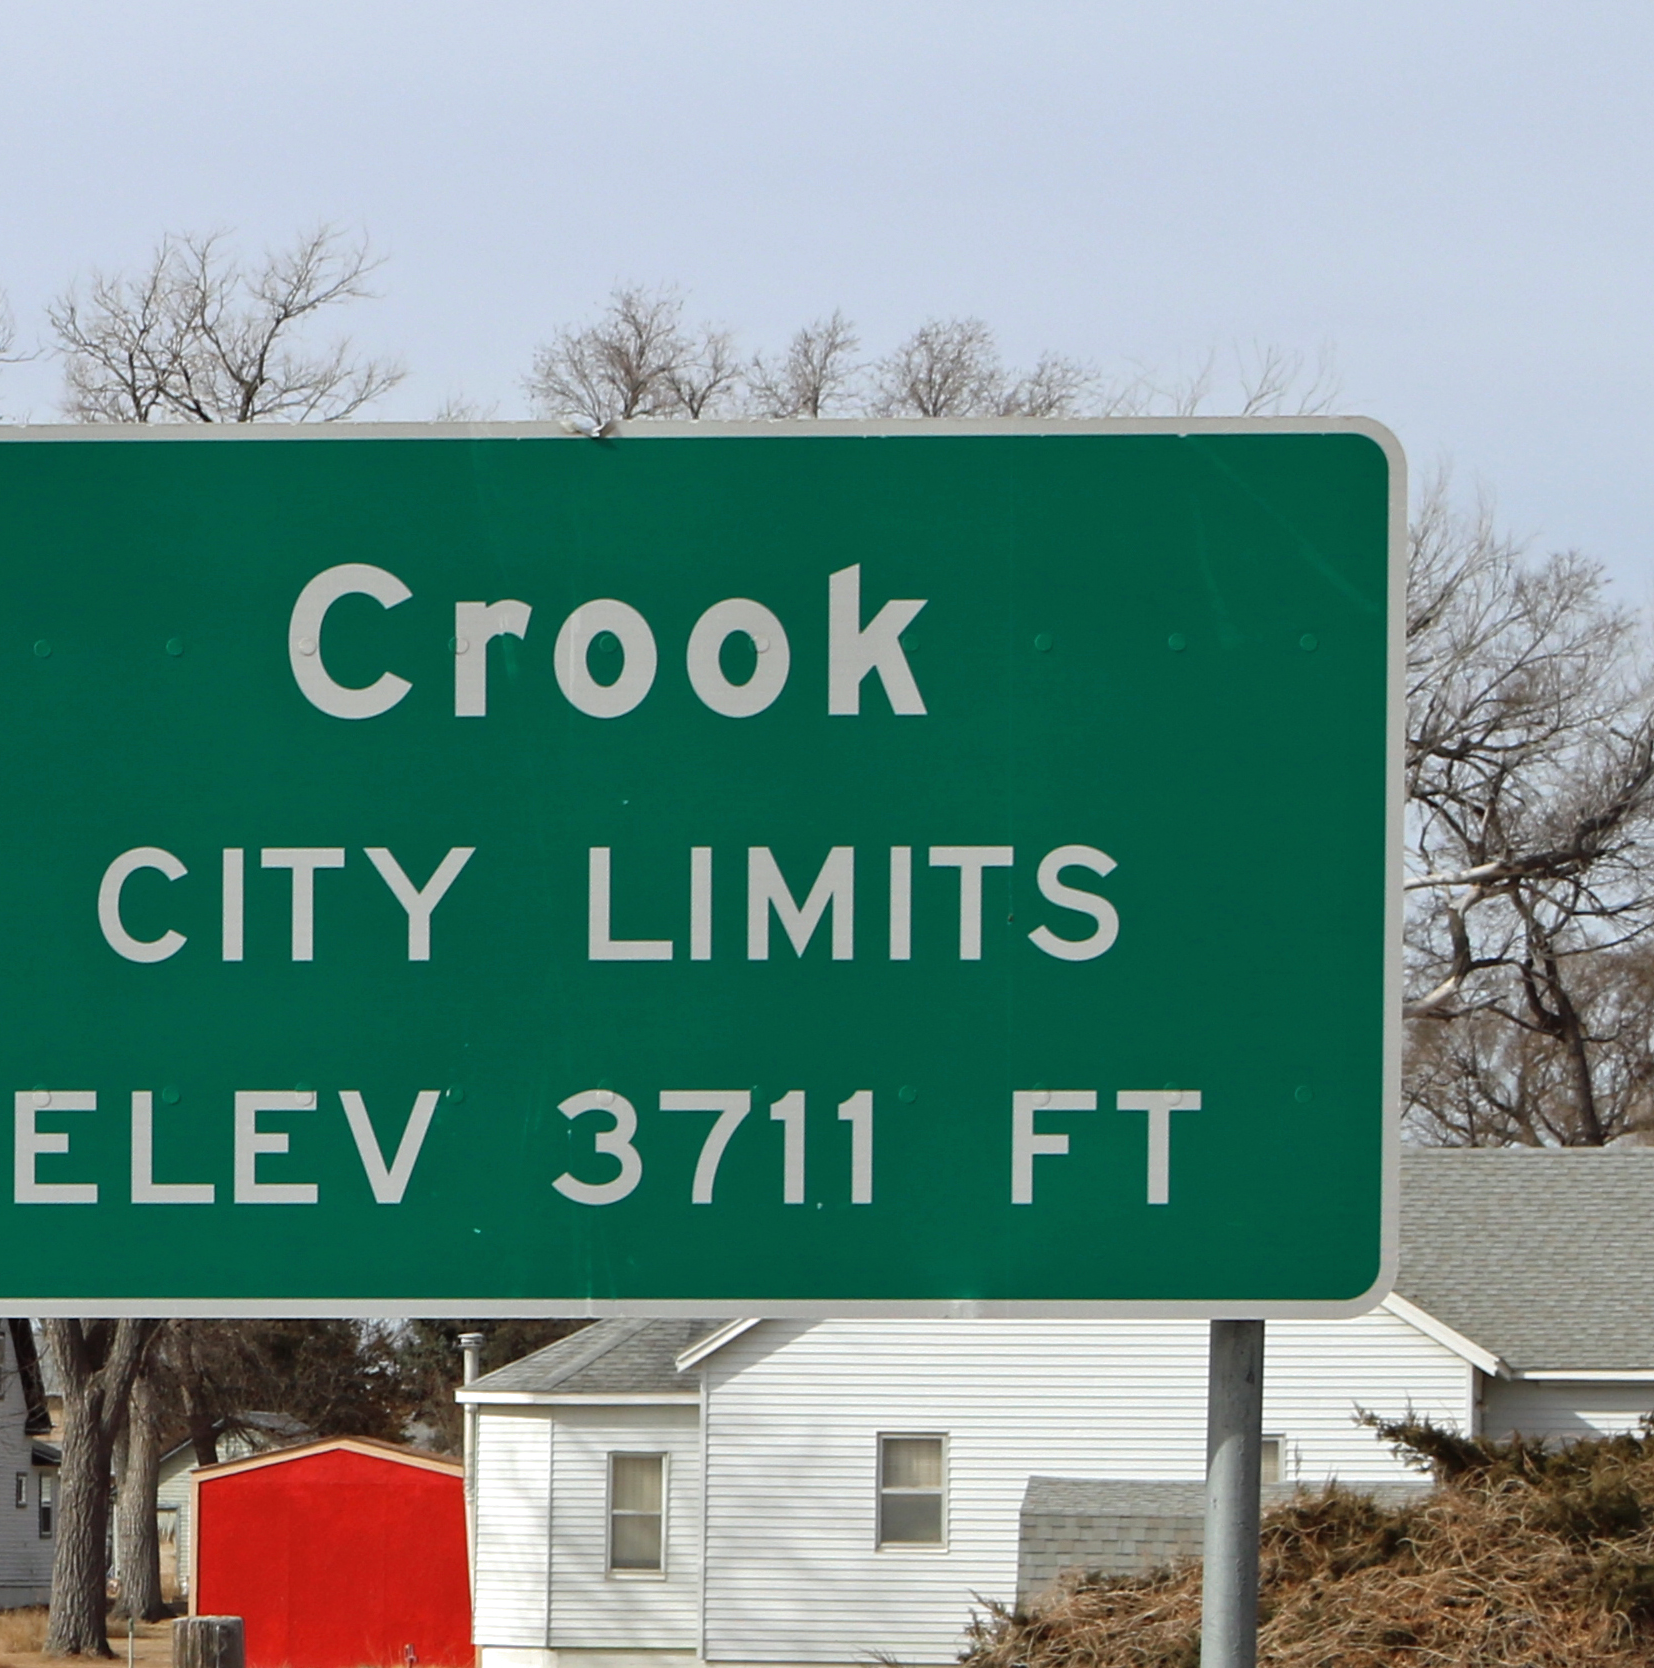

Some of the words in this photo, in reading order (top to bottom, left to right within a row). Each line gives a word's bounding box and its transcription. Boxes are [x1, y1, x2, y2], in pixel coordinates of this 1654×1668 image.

[288, 563, 927, 719] Crook
[98, 846, 476, 963] CITY
[588, 844, 1119, 961] LIMITS
[14, 1090, 441, 1204] ELEV
[552, 1089, 873, 1205] 3711
[1011, 1090, 1202, 1204] FT
